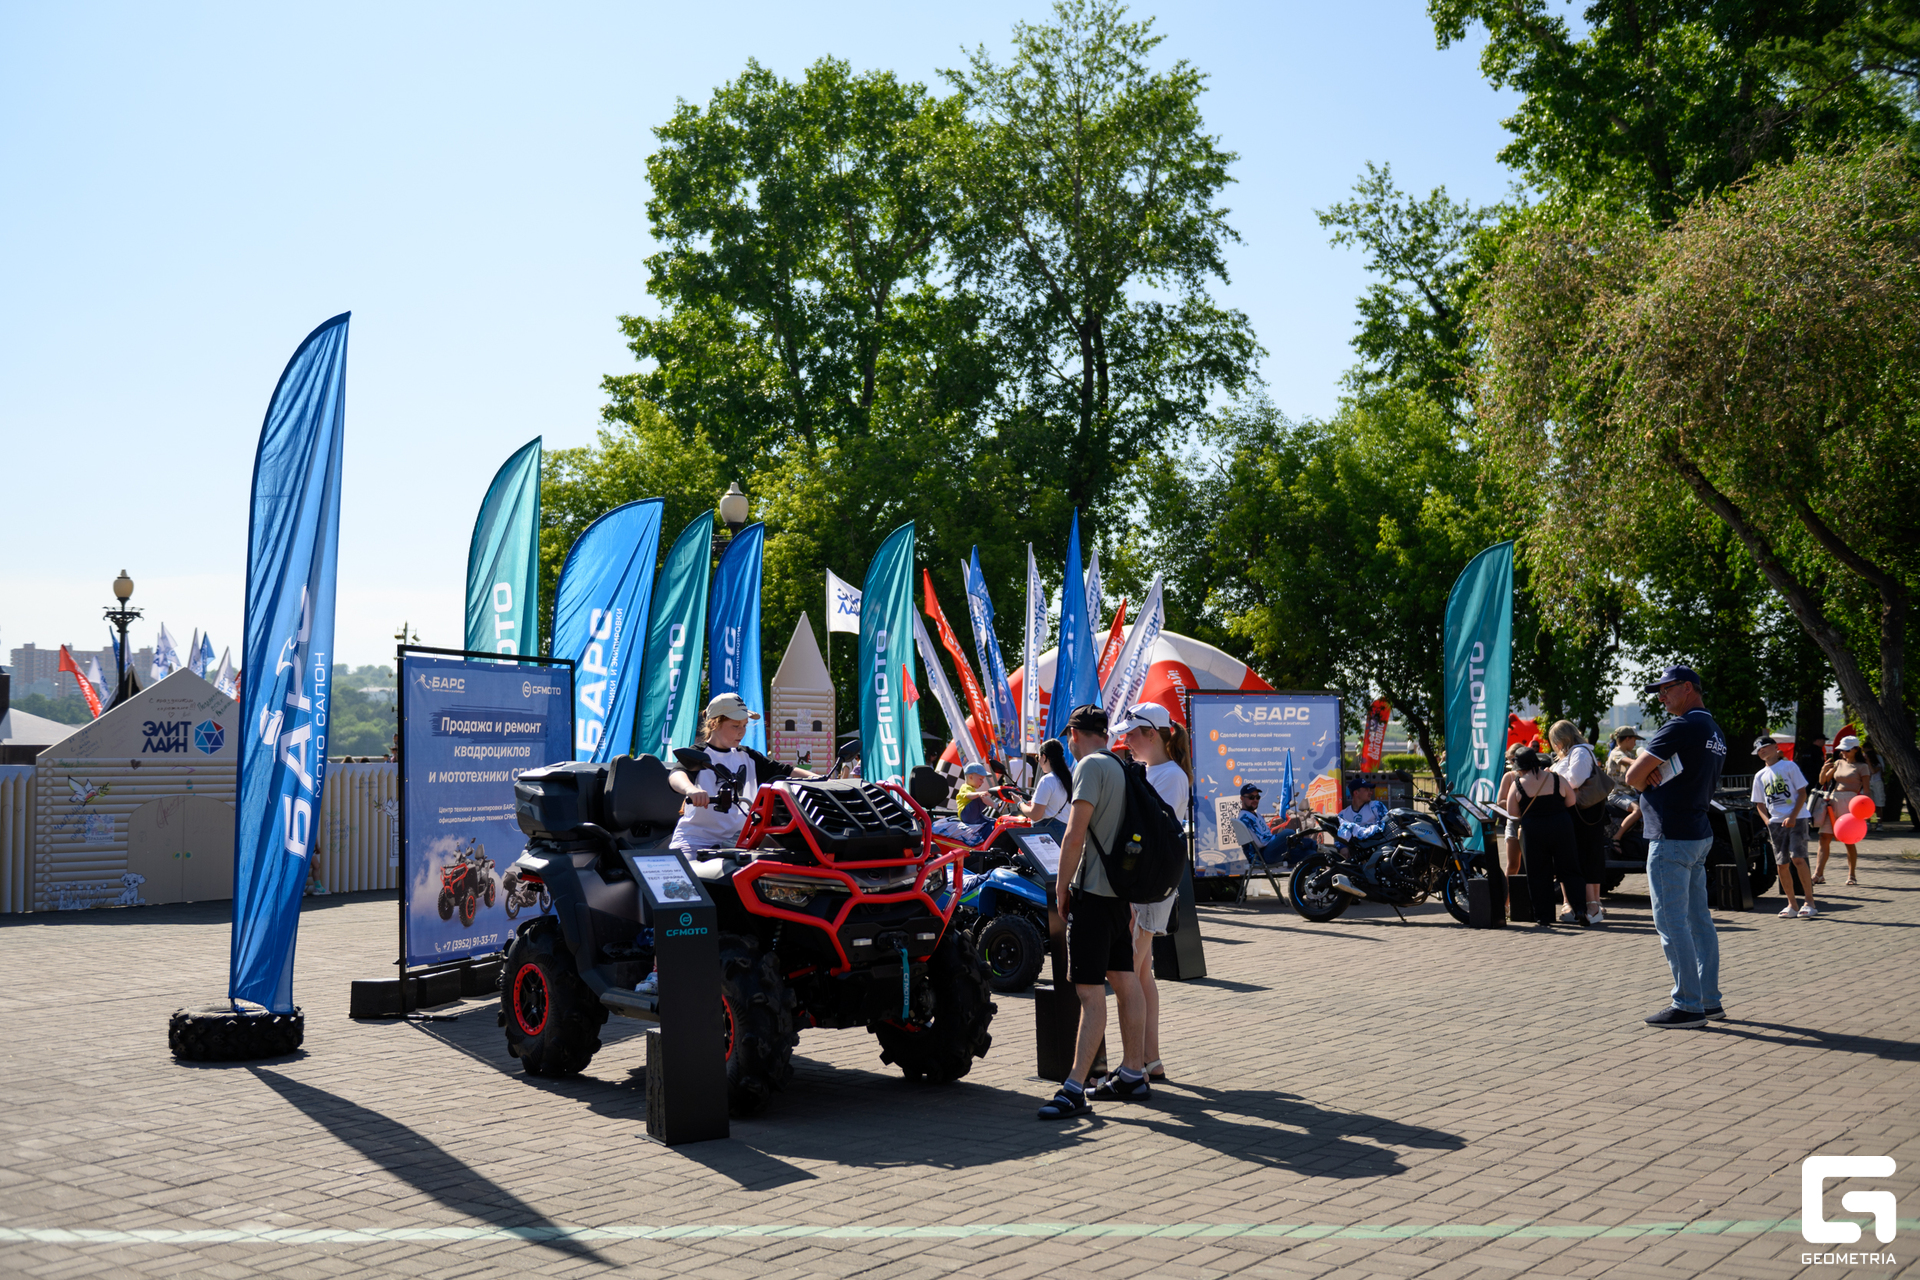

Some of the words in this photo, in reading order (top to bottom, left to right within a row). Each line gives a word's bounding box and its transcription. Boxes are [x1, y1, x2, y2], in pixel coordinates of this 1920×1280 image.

[611, 608, 623, 668] ЭКИПИРОВКИ
[431, 676, 465, 690] БАРС
[576, 607, 612, 752] БАРС
[314, 652, 326, 727] САЛОН
[532, 685, 562, 696] CFMOTO
[875, 629, 901, 767] CFMOTO
[1105, 678, 1129, 720] ДНЁМ
[1469, 641, 1491, 770] CFMOTO
[1254, 706, 1310, 721] БАРС
[142, 720, 192, 737] ЭЛИТ
[441, 716, 493, 735] Продажа
[495, 721, 502, 733] и
[504, 722, 542, 736] ремонт
[141, 736, 188, 753] ЛАЙН
[454, 745, 531, 760] квадроциклов
[1220, 746, 1225, 754] 2
[1705, 739, 1727, 755] БАРС
[315, 735, 326, 798] МОТО
[428, 771, 436, 783] и
[439, 770, 508, 783] мототехники
[438, 806, 453, 814] Центр
[476, 805, 502, 813] экипировки
[438, 815, 471, 824] официальный
[472, 815, 485, 823] дилер
[666, 927, 708, 937] CFMOTO
[443, 941, 451, 951] +7
[452, 938, 472, 952] (3952)
[472, 933, 498, 947] 91-33-77
